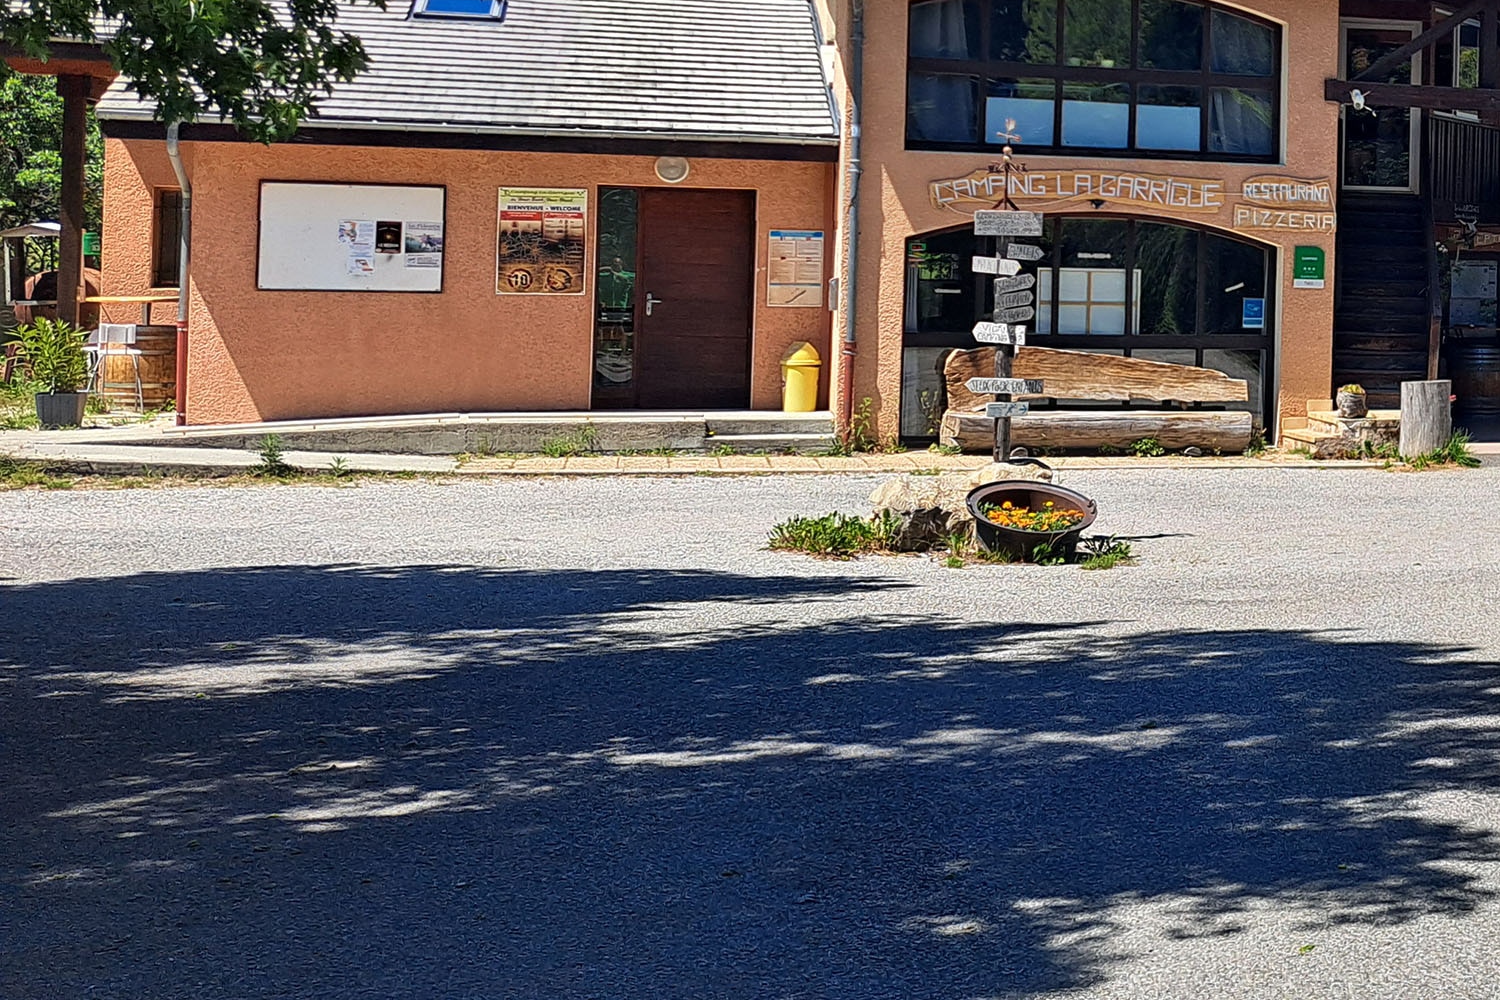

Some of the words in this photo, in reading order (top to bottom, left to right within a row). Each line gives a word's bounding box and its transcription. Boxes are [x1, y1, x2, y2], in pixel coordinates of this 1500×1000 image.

[935, 175, 1046, 202] CAMPING
[1056, 174, 1092, 197] LA
[1100, 175, 1221, 207] GARRIGUE
[1244, 183, 1329, 202] RESTAURANT
[1236, 208, 1335, 229] PIZZERIA
